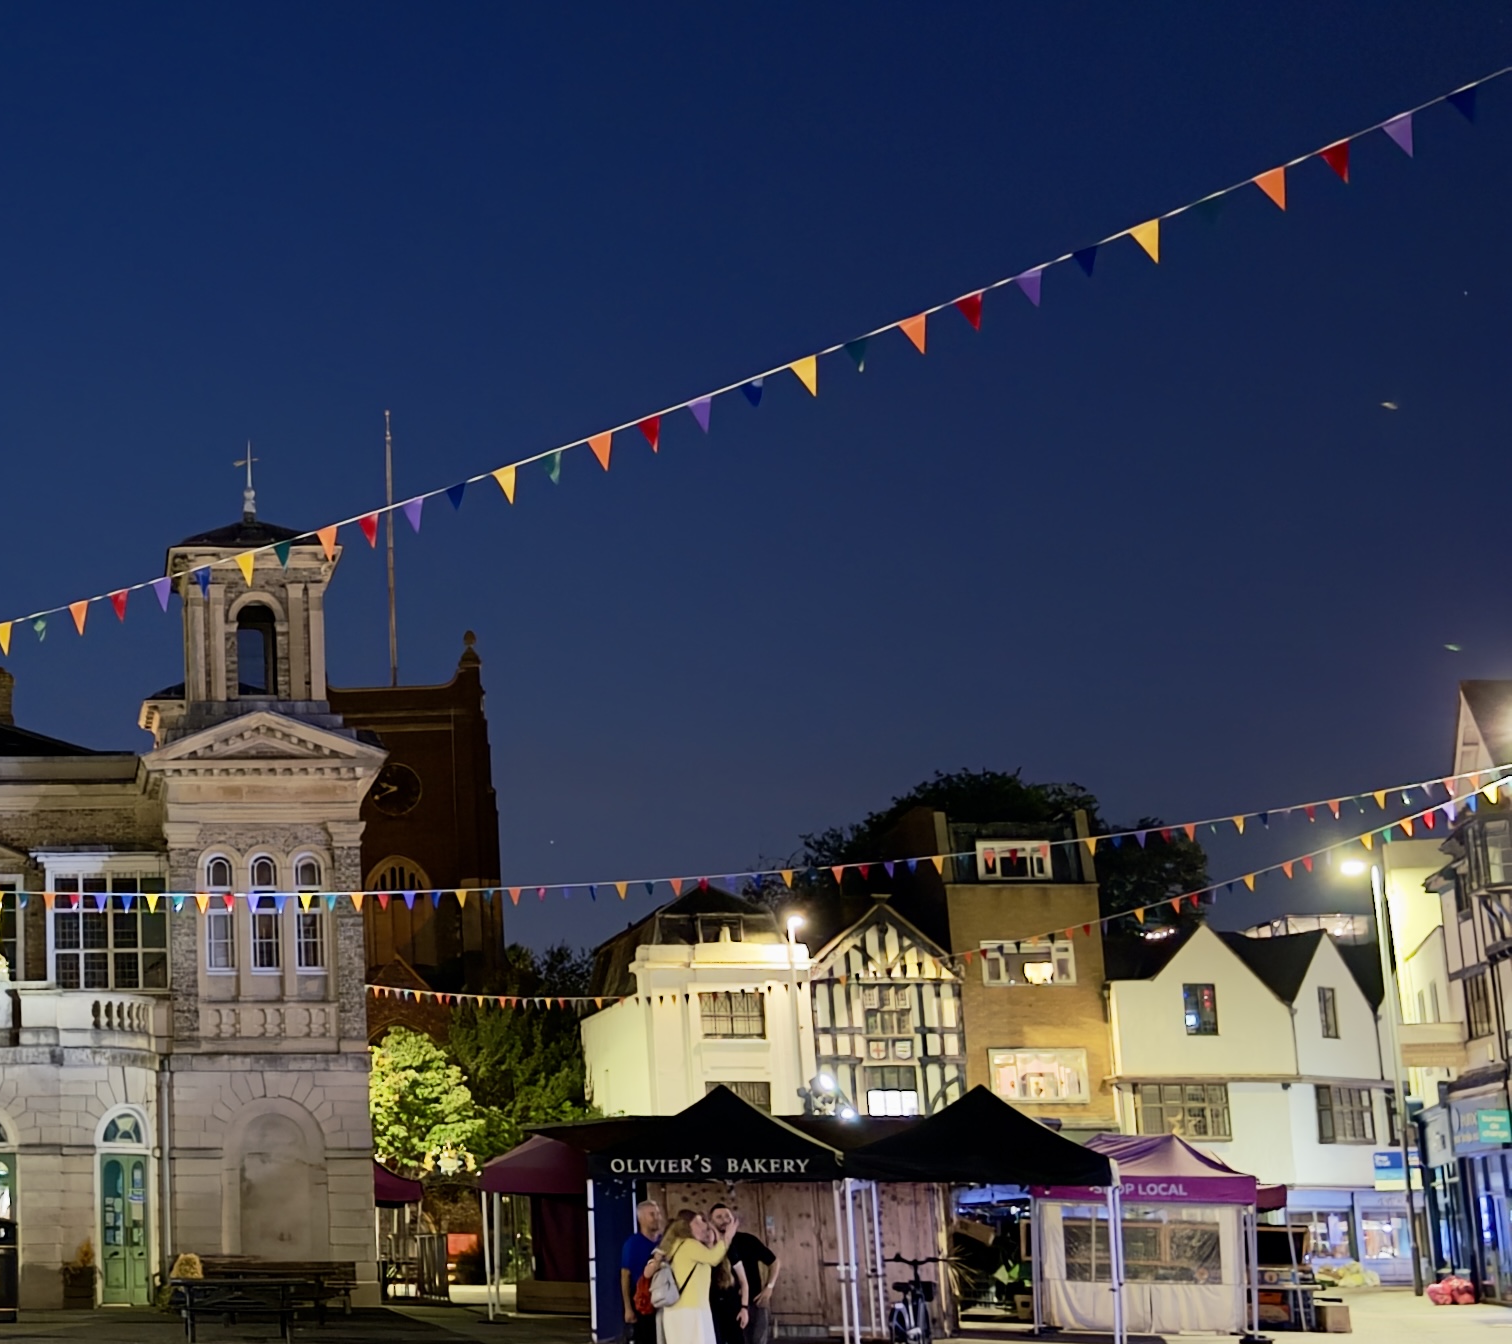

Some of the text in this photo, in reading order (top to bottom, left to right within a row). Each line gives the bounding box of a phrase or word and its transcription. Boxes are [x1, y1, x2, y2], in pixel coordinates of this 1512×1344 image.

[610, 1154, 810, 1174] OLIVIER'S BAKERY
[1137, 1183, 1188, 1196] LOCAL
